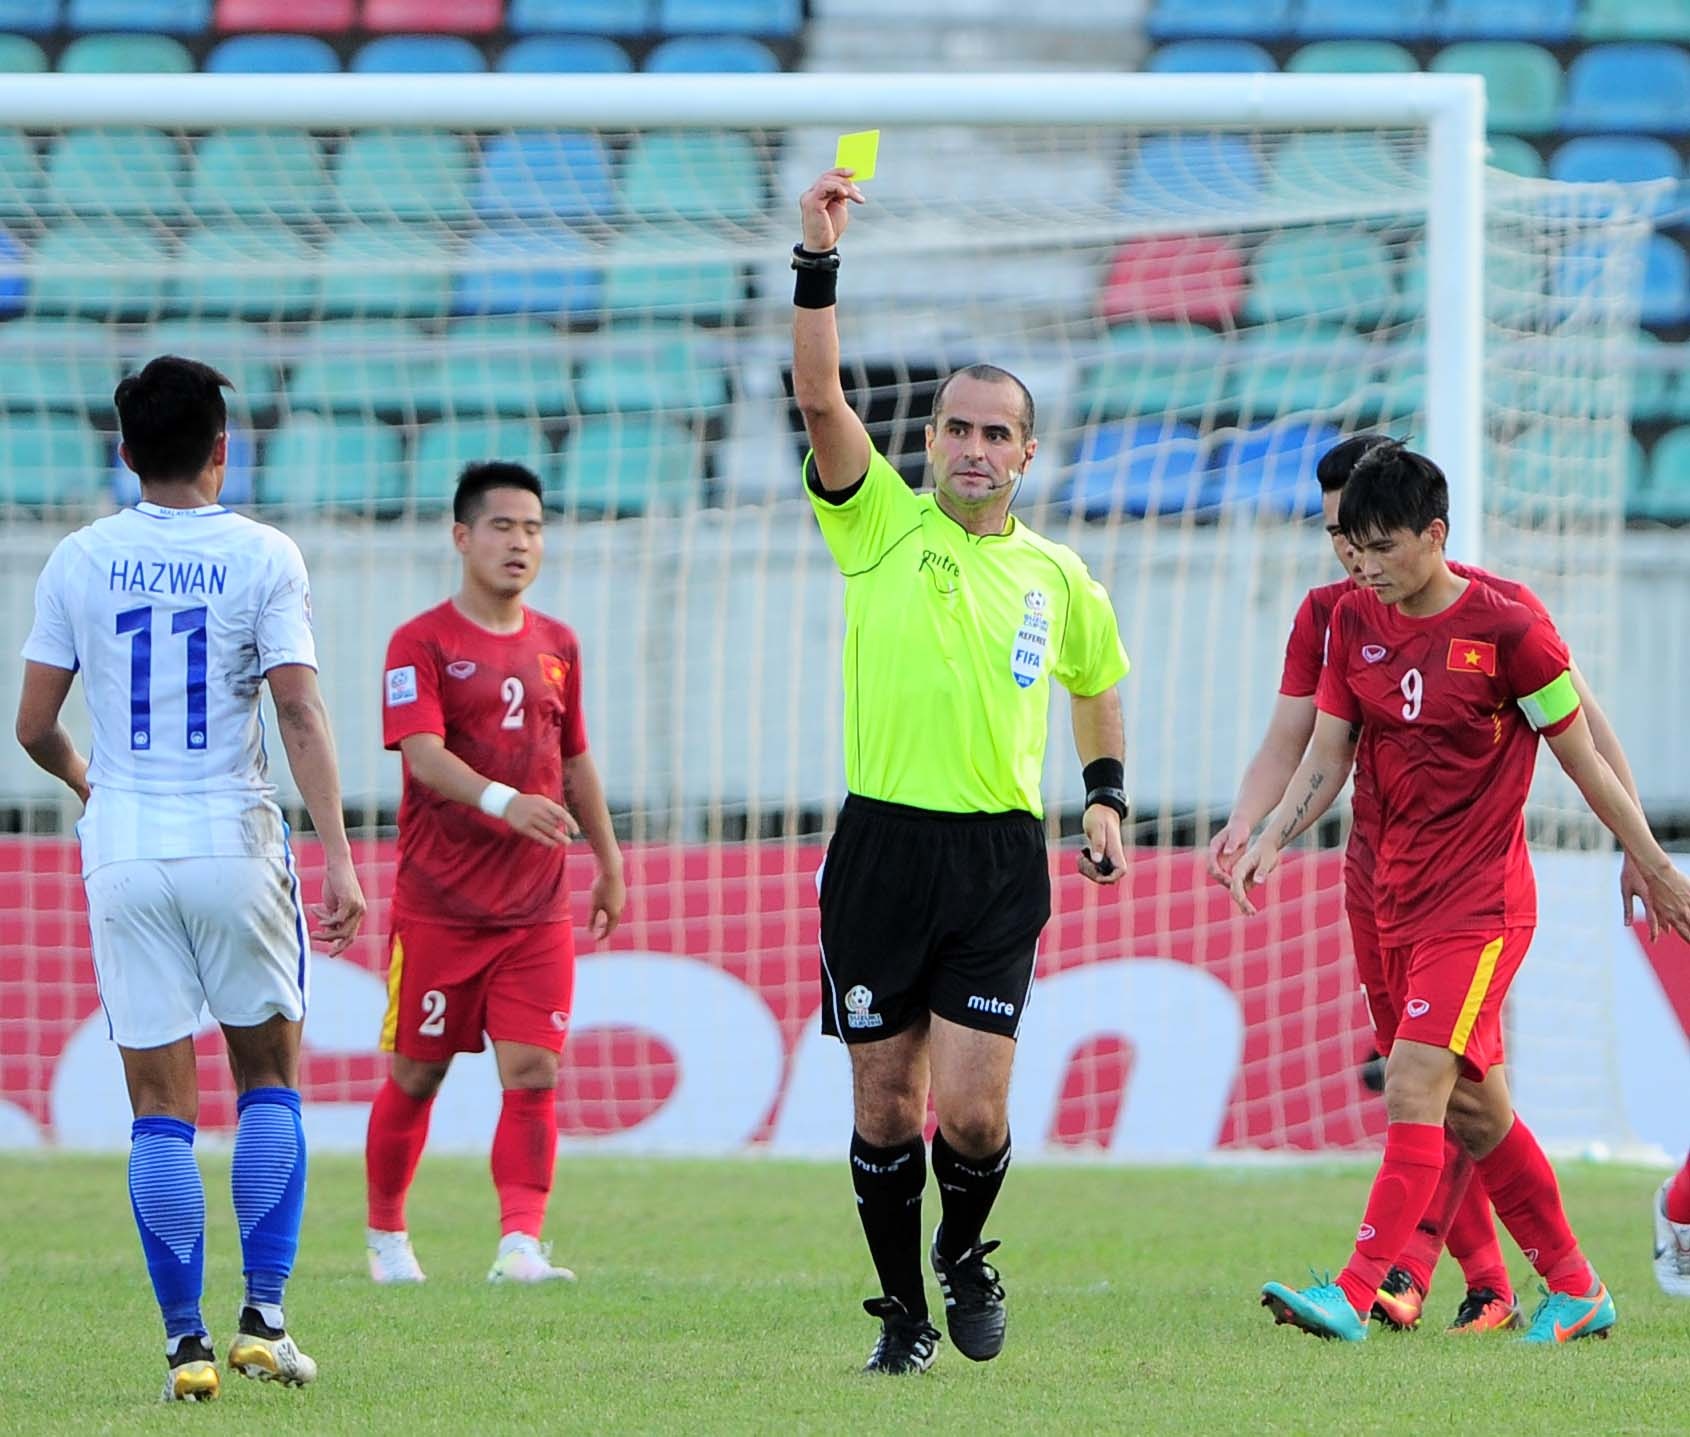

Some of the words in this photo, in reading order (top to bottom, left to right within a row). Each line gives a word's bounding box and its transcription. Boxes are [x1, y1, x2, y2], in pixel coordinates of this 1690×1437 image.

[110, 559, 227, 594] HAZWAN
[919, 550, 959, 577] mitre
[115, 605, 208, 750] 11
[1015, 649, 1040, 668] FIFA
[500, 676, 525, 730] 2
[1400, 668, 1423, 721] 9
[418, 989, 447, 1037] 2
[967, 995, 1015, 1016] mitre
